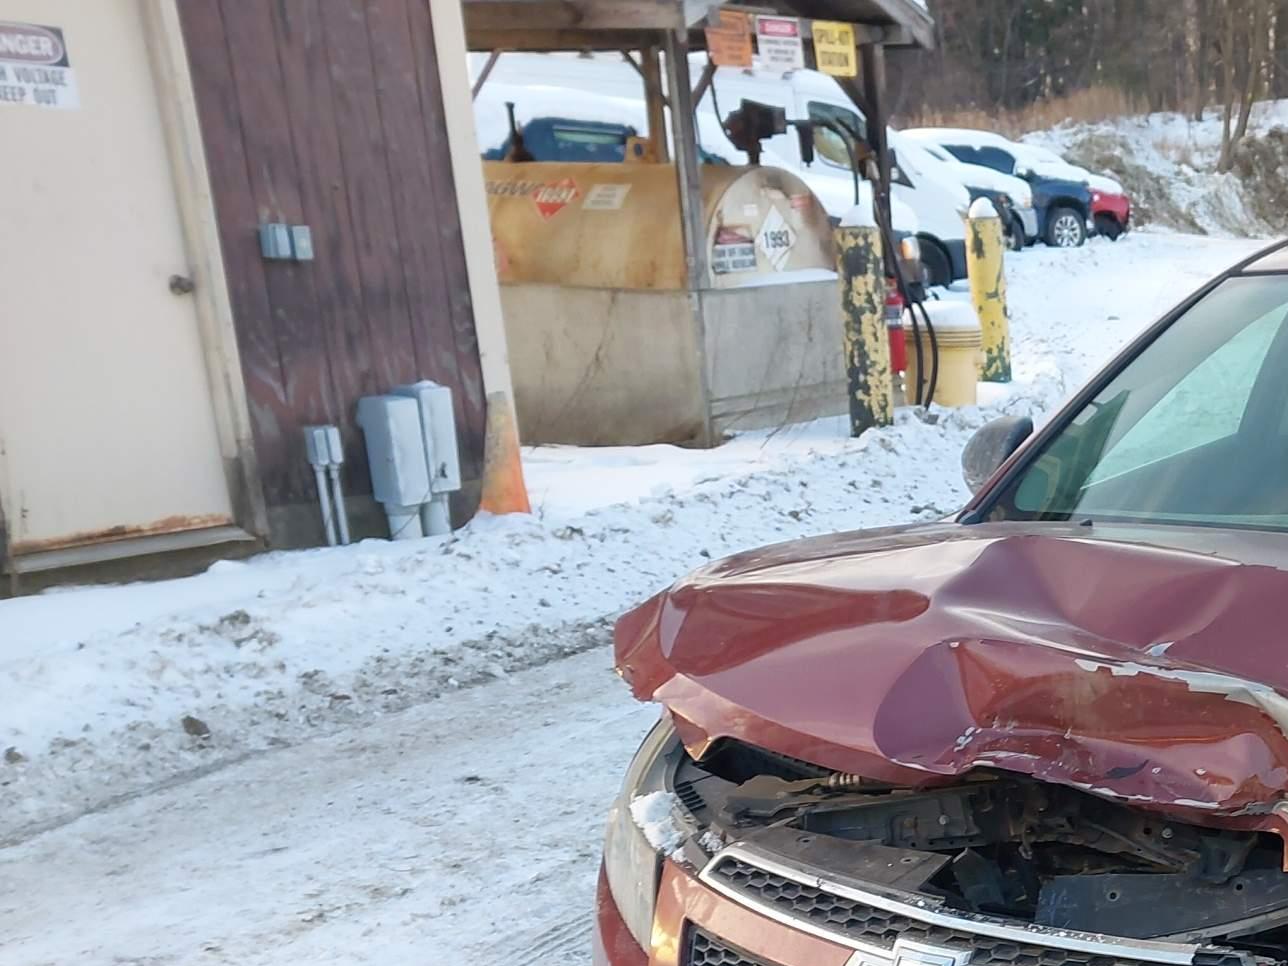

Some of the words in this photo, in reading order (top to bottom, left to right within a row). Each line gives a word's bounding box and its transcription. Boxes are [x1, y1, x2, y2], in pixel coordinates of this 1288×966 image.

[0, 33, 53, 57] NGER
[820, 51, 849, 67] STATION
[14, 67, 67, 87] VOLTAGE
[0, 85, 26, 102] EEP
[33, 87, 57, 105] OUT
[764, 230, 790, 248] 1993
